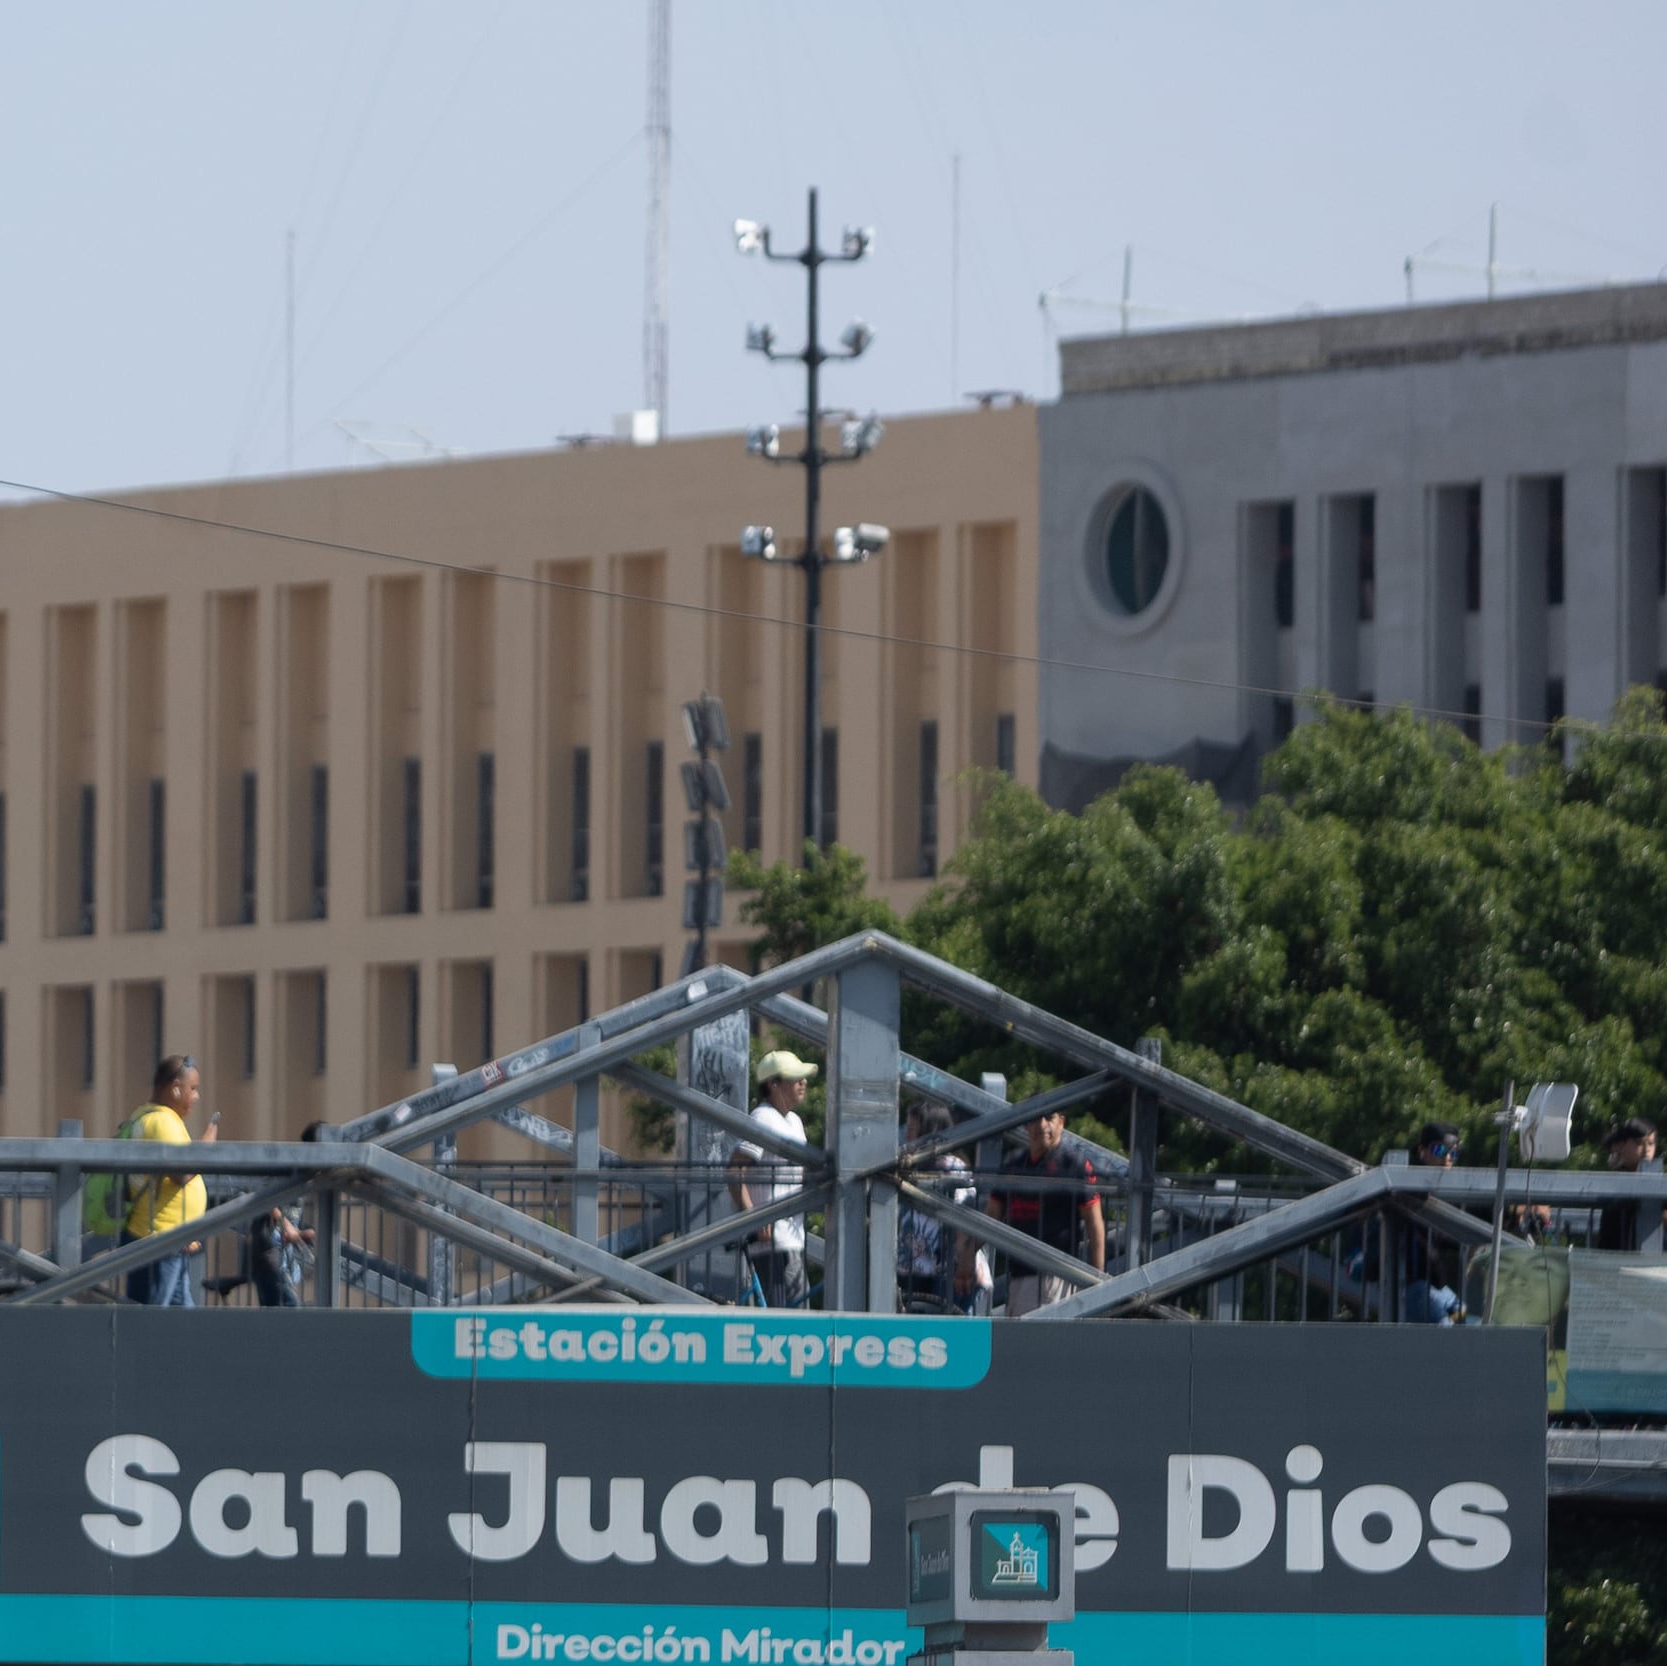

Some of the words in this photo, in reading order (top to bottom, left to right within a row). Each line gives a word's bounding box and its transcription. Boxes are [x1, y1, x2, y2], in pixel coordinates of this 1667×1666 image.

[454, 1318, 707, 1362] Estación
[723, 1323, 948, 1377] Express
[80, 1433, 402, 1558] San
[447, 1441, 872, 1566] Juan
[1166, 1444, 1512, 1573] Dios
[496, 1624, 711, 1662] Dirección
[720, 1628, 906, 1666] Mirador
